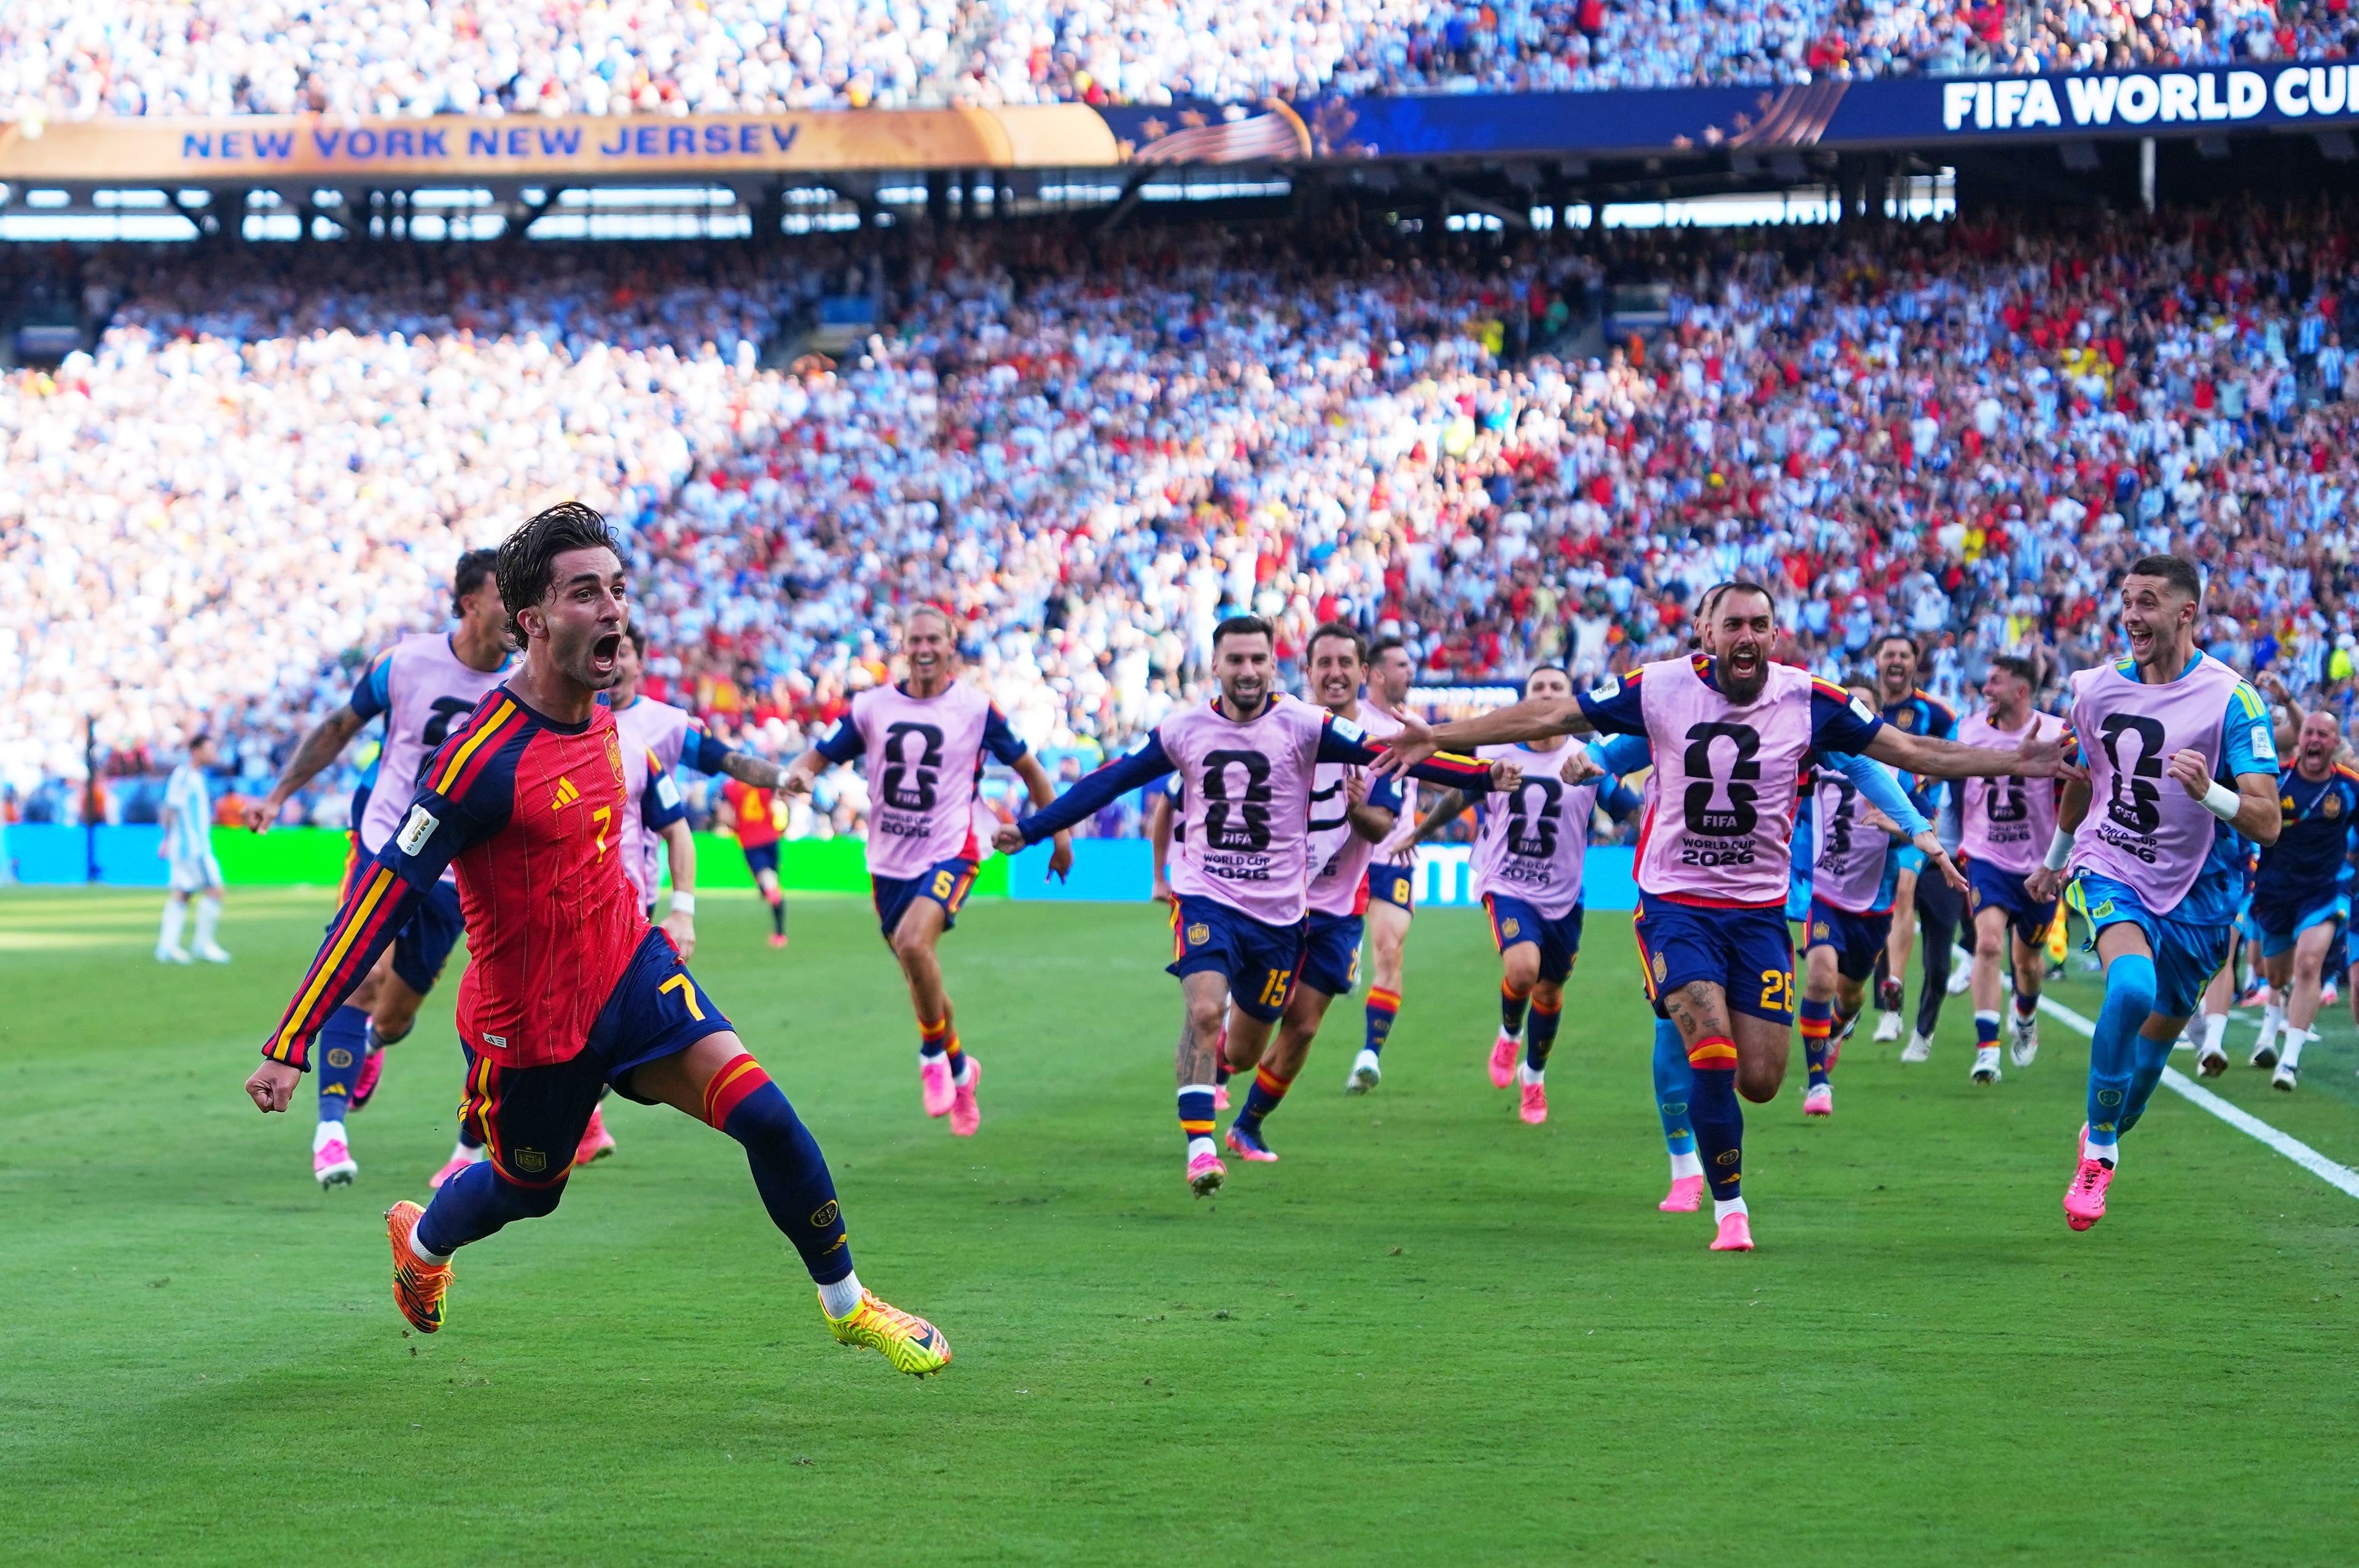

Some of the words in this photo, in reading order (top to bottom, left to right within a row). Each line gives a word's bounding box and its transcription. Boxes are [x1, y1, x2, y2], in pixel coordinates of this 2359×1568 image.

[1944, 79, 2061, 130] FIFA
[2066, 71, 2267, 125] WORLD
[183, 130, 292, 158] NEW
[313, 128, 448, 159] YORK
[469, 125, 581, 157] NEW
[600, 123, 799, 156] JERSEY
[593, 805, 611, 864] 7
[1702, 815, 1738, 828] FIFA
[1221, 832, 1253, 846] FIFA
[1683, 837, 1729, 850] WORLD
[1731, 839, 1756, 849] CUP
[1203, 854, 1245, 865] WORLD
[1247, 855, 1270, 866] CUP
[1681, 849, 1755, 867] 2026
[658, 972, 706, 1021] 7
[1259, 968, 1291, 1007] 15
